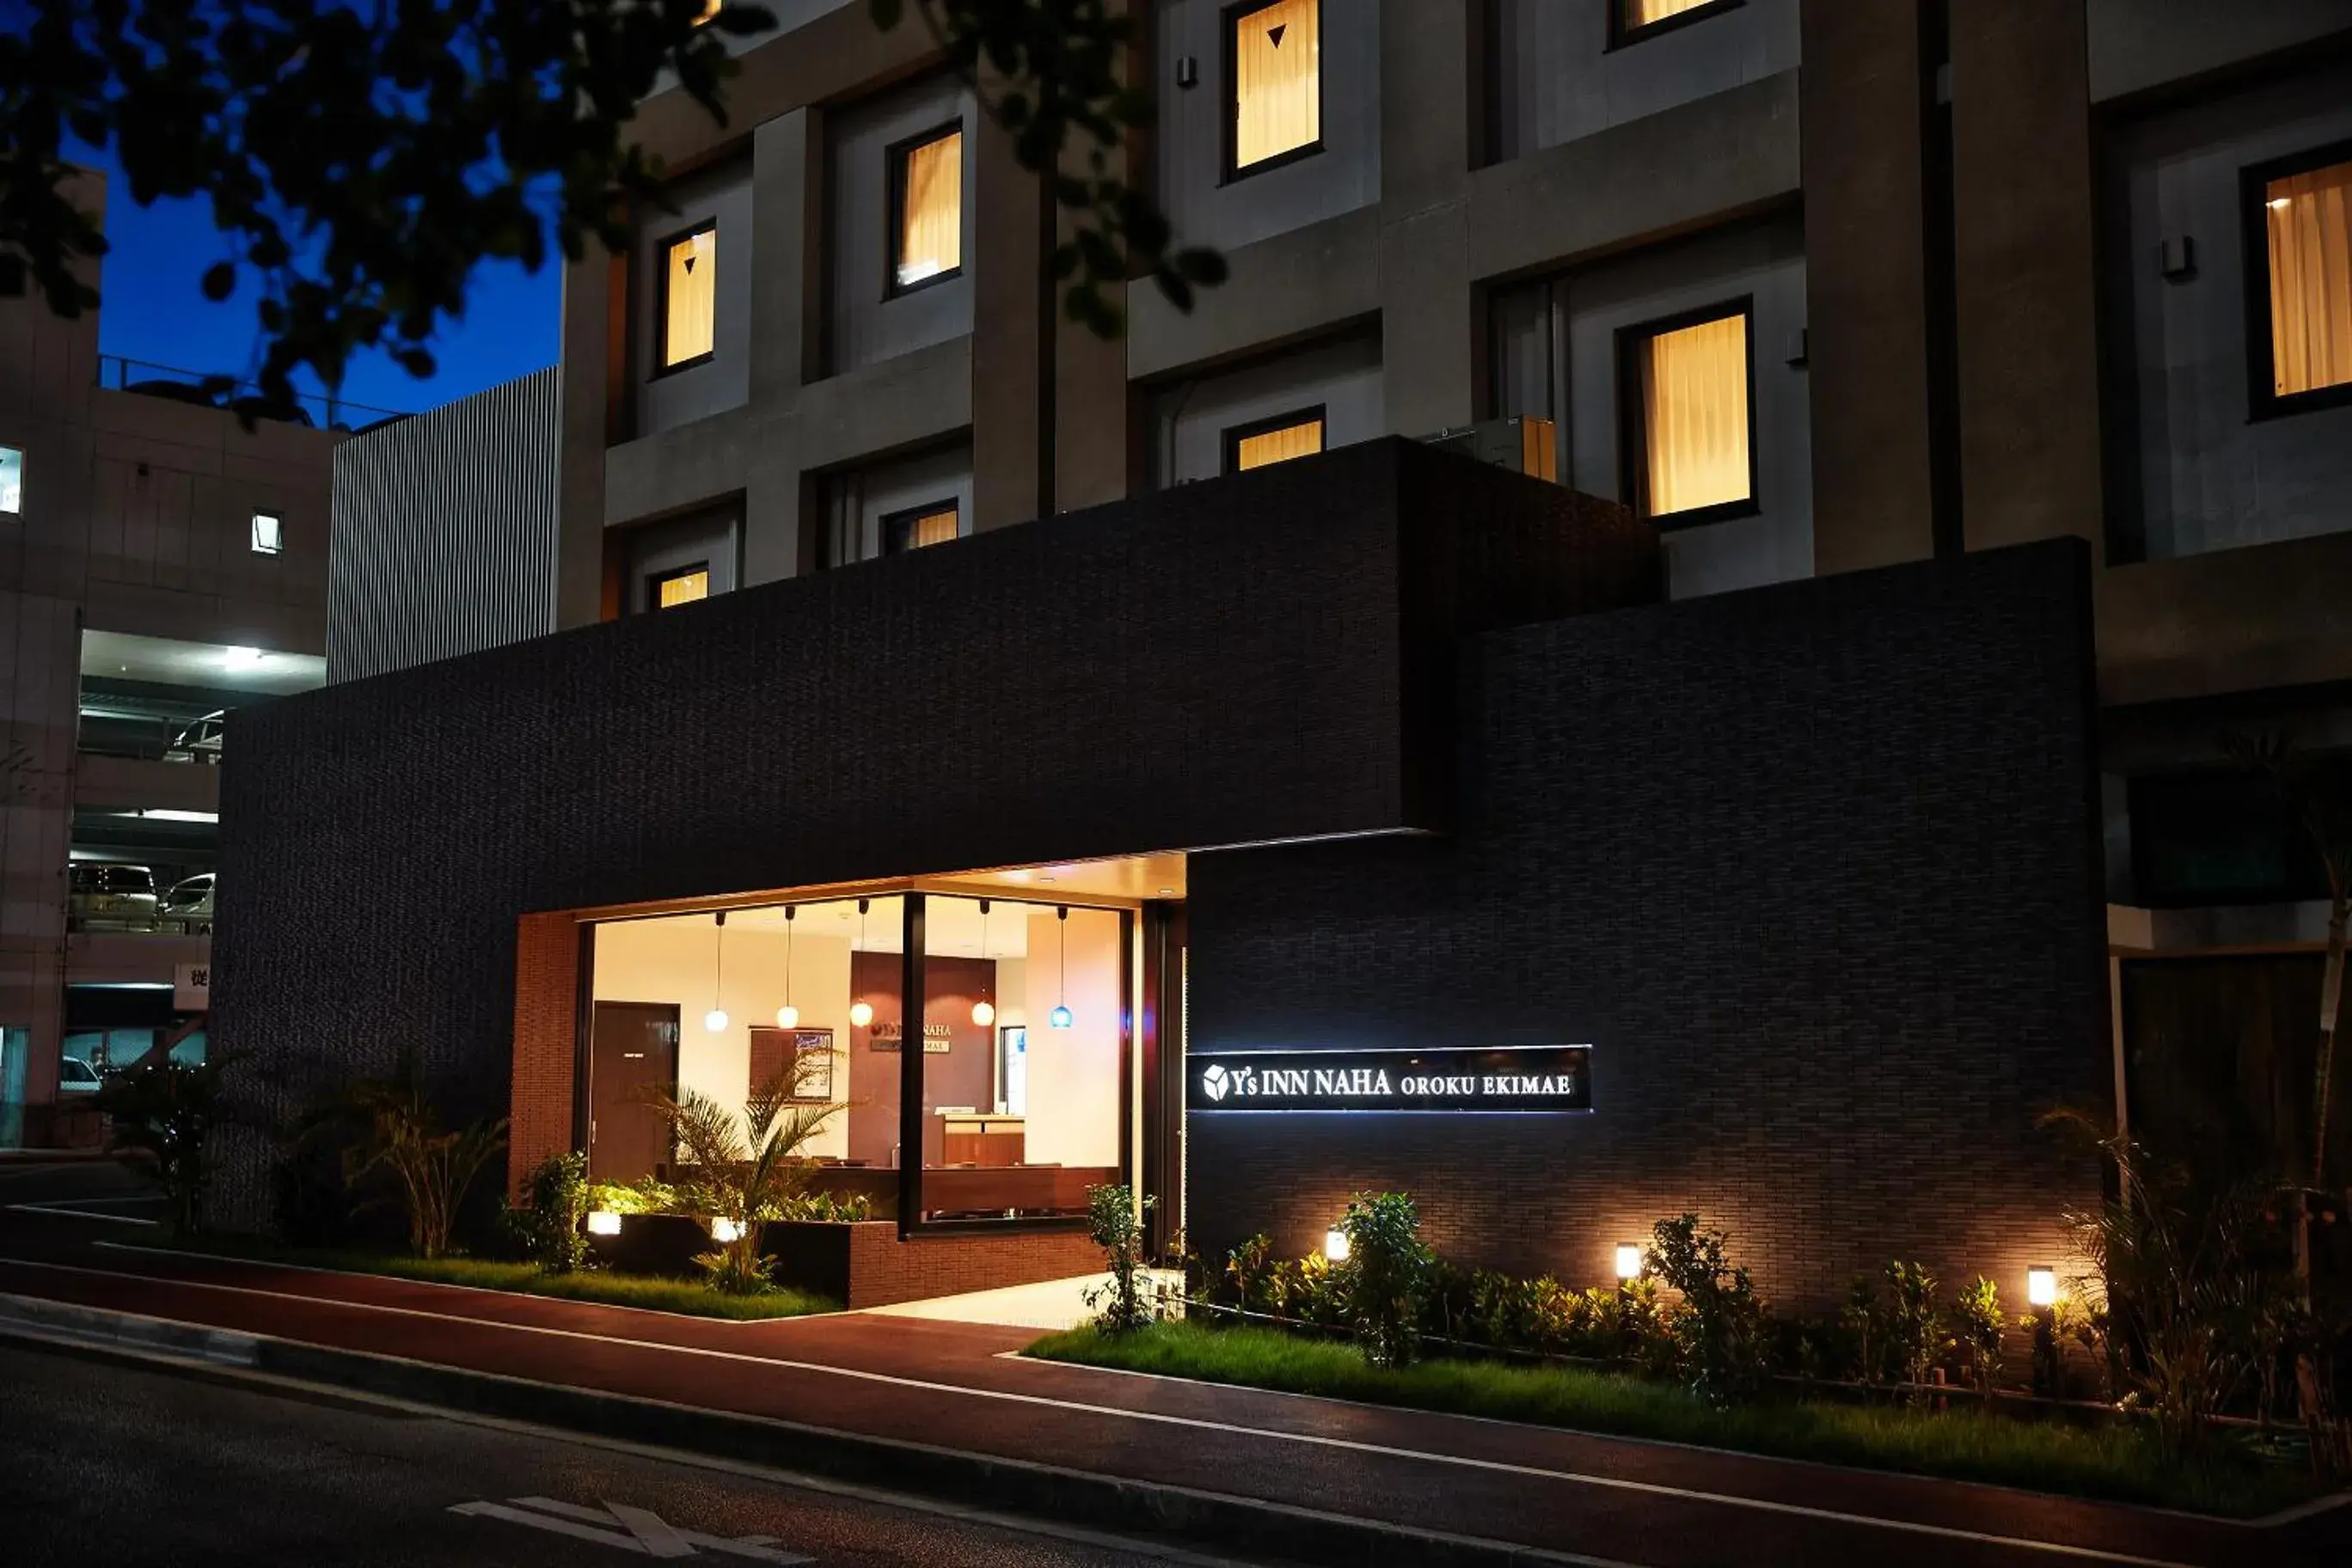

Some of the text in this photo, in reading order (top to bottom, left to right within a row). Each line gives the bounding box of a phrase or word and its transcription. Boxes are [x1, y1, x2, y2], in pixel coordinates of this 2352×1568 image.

[1231, 1066, 1571, 1095] Y's INN NAHA OROKU EKIMAE
